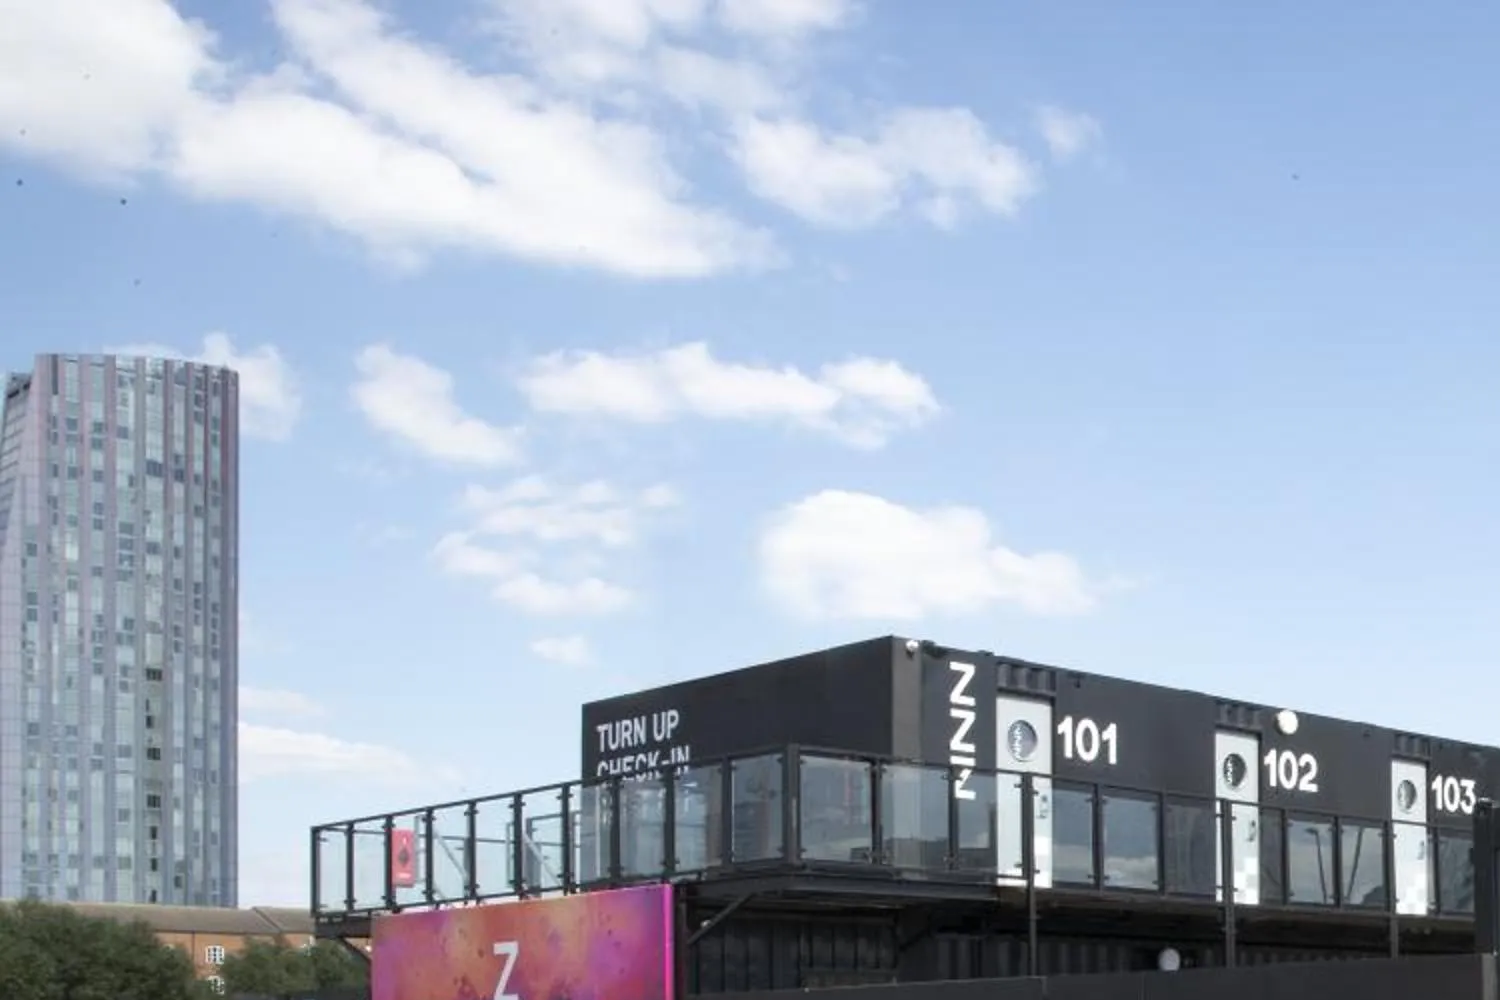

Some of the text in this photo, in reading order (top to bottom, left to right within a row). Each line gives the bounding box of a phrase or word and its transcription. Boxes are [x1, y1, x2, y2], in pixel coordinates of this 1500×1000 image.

[596, 709, 680, 752] TURN UP
[1057, 715, 1117, 765] 101
[1263, 749, 1318, 792] 102
[1431, 774, 1477, 814] 103
